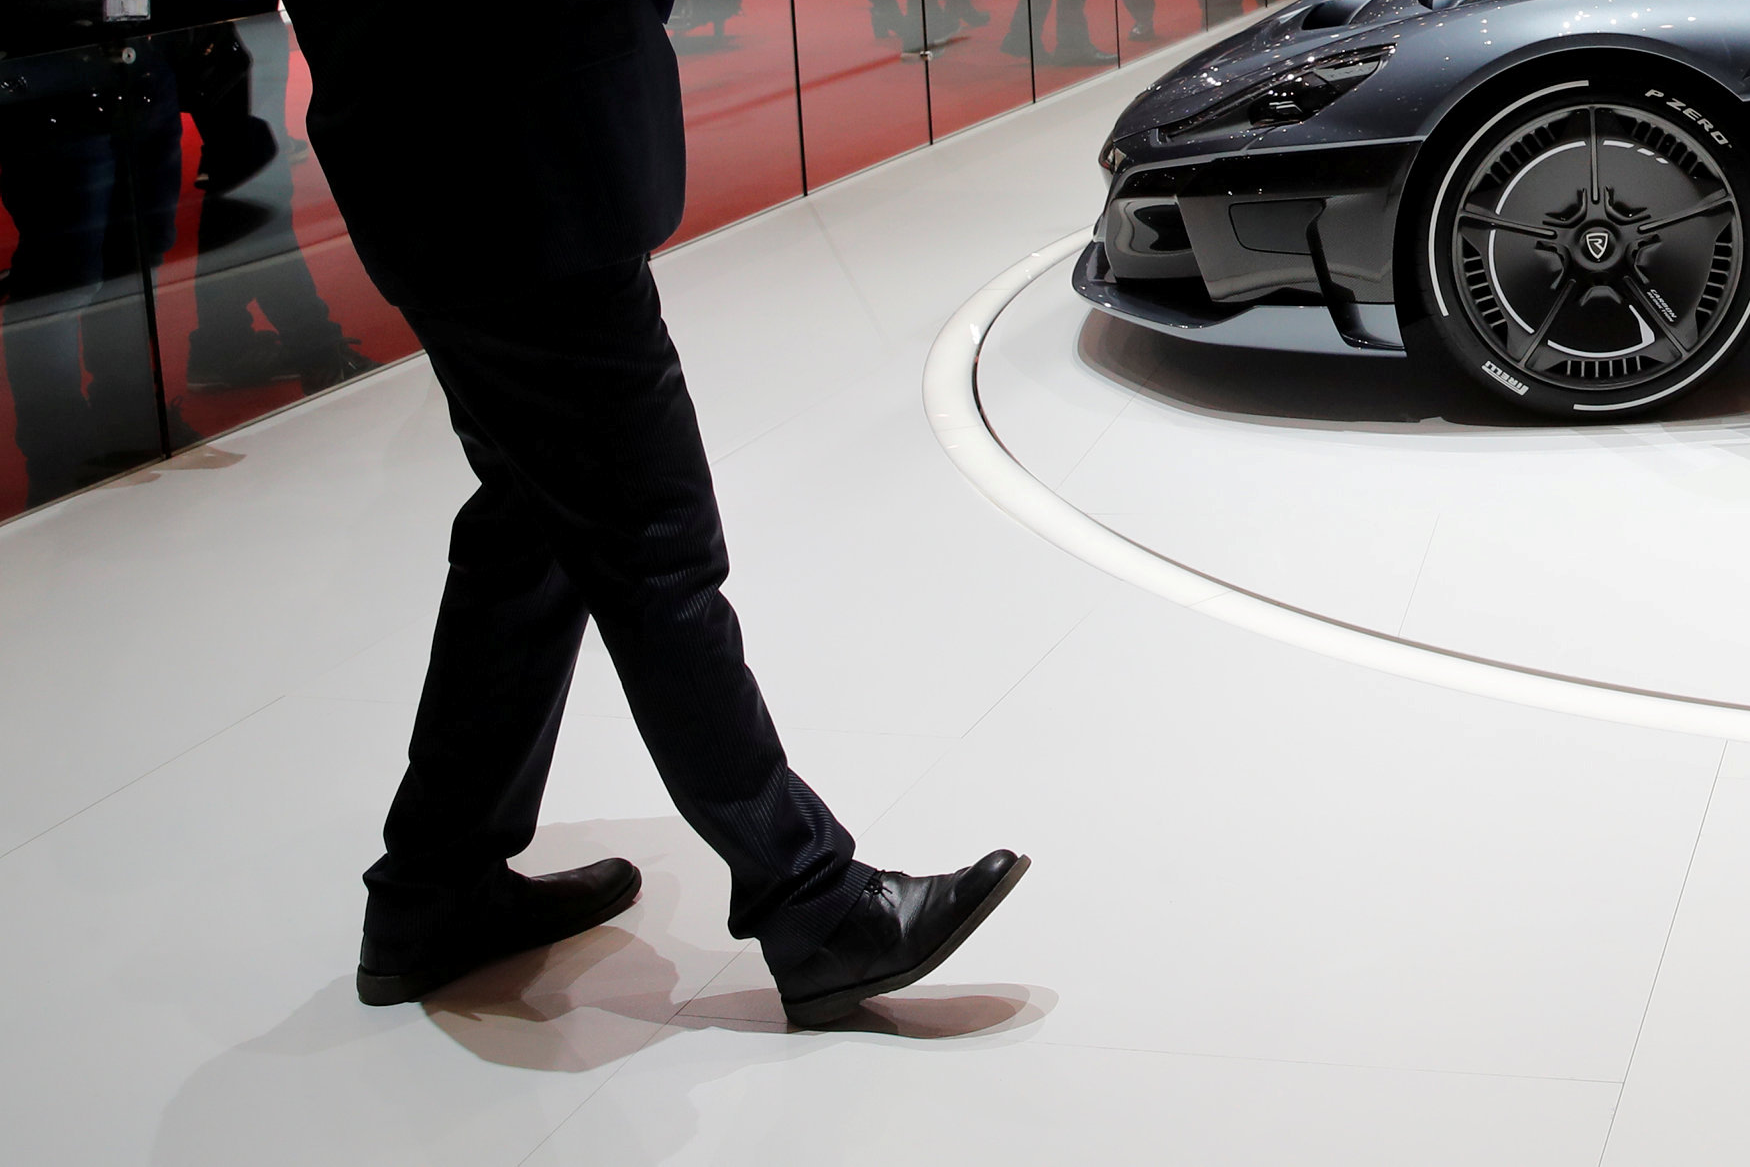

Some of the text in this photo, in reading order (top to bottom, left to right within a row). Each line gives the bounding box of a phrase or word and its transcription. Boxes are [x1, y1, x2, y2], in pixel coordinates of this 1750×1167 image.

[1644, 89, 1729, 145] P ZERO
[1649, 288, 1678, 319] CARBON
[1481, 360, 1530, 396] PIRELLI
